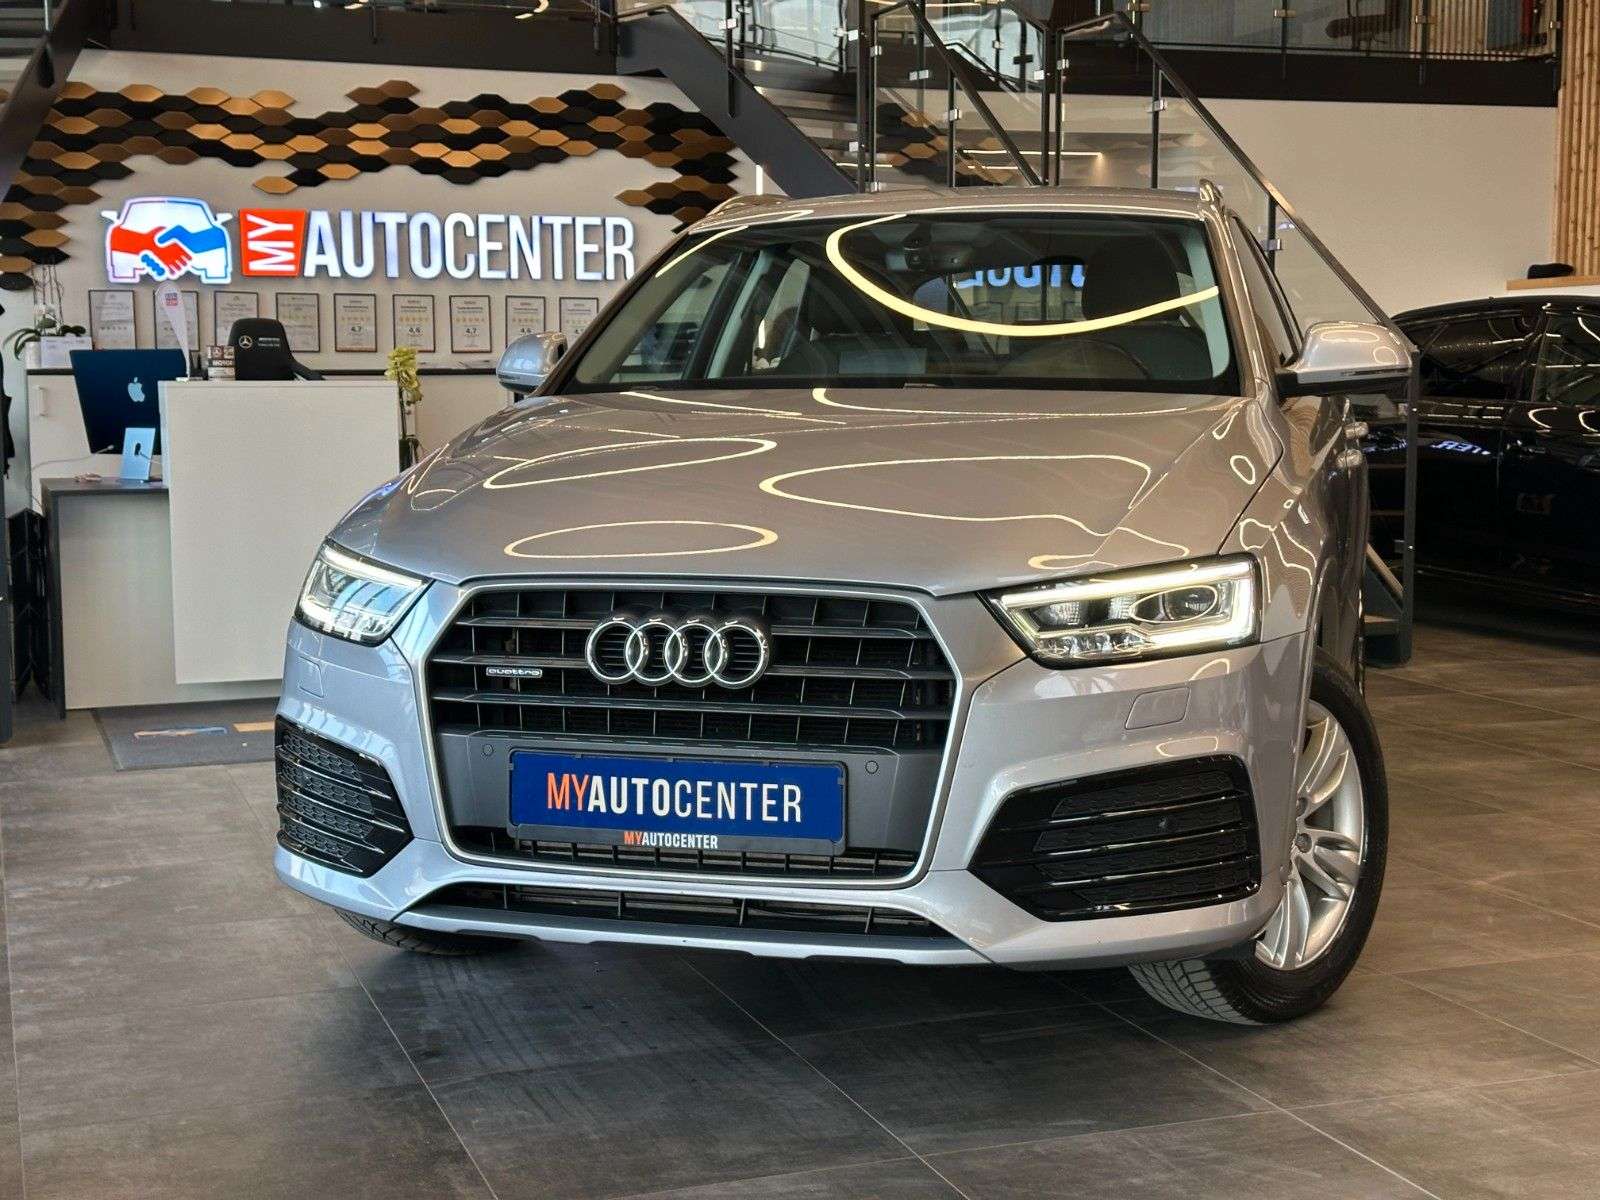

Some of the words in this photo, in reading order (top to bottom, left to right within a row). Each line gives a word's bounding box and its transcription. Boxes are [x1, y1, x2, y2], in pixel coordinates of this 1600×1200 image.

[246, 213, 296, 272] MY
[304, 209, 636, 281] AUTOCENTER
[488, 668, 540, 676] quattro
[546, 772, 803, 823] MYAUTOCENTER
[623, 831, 719, 850] MYAUTOCENTER
